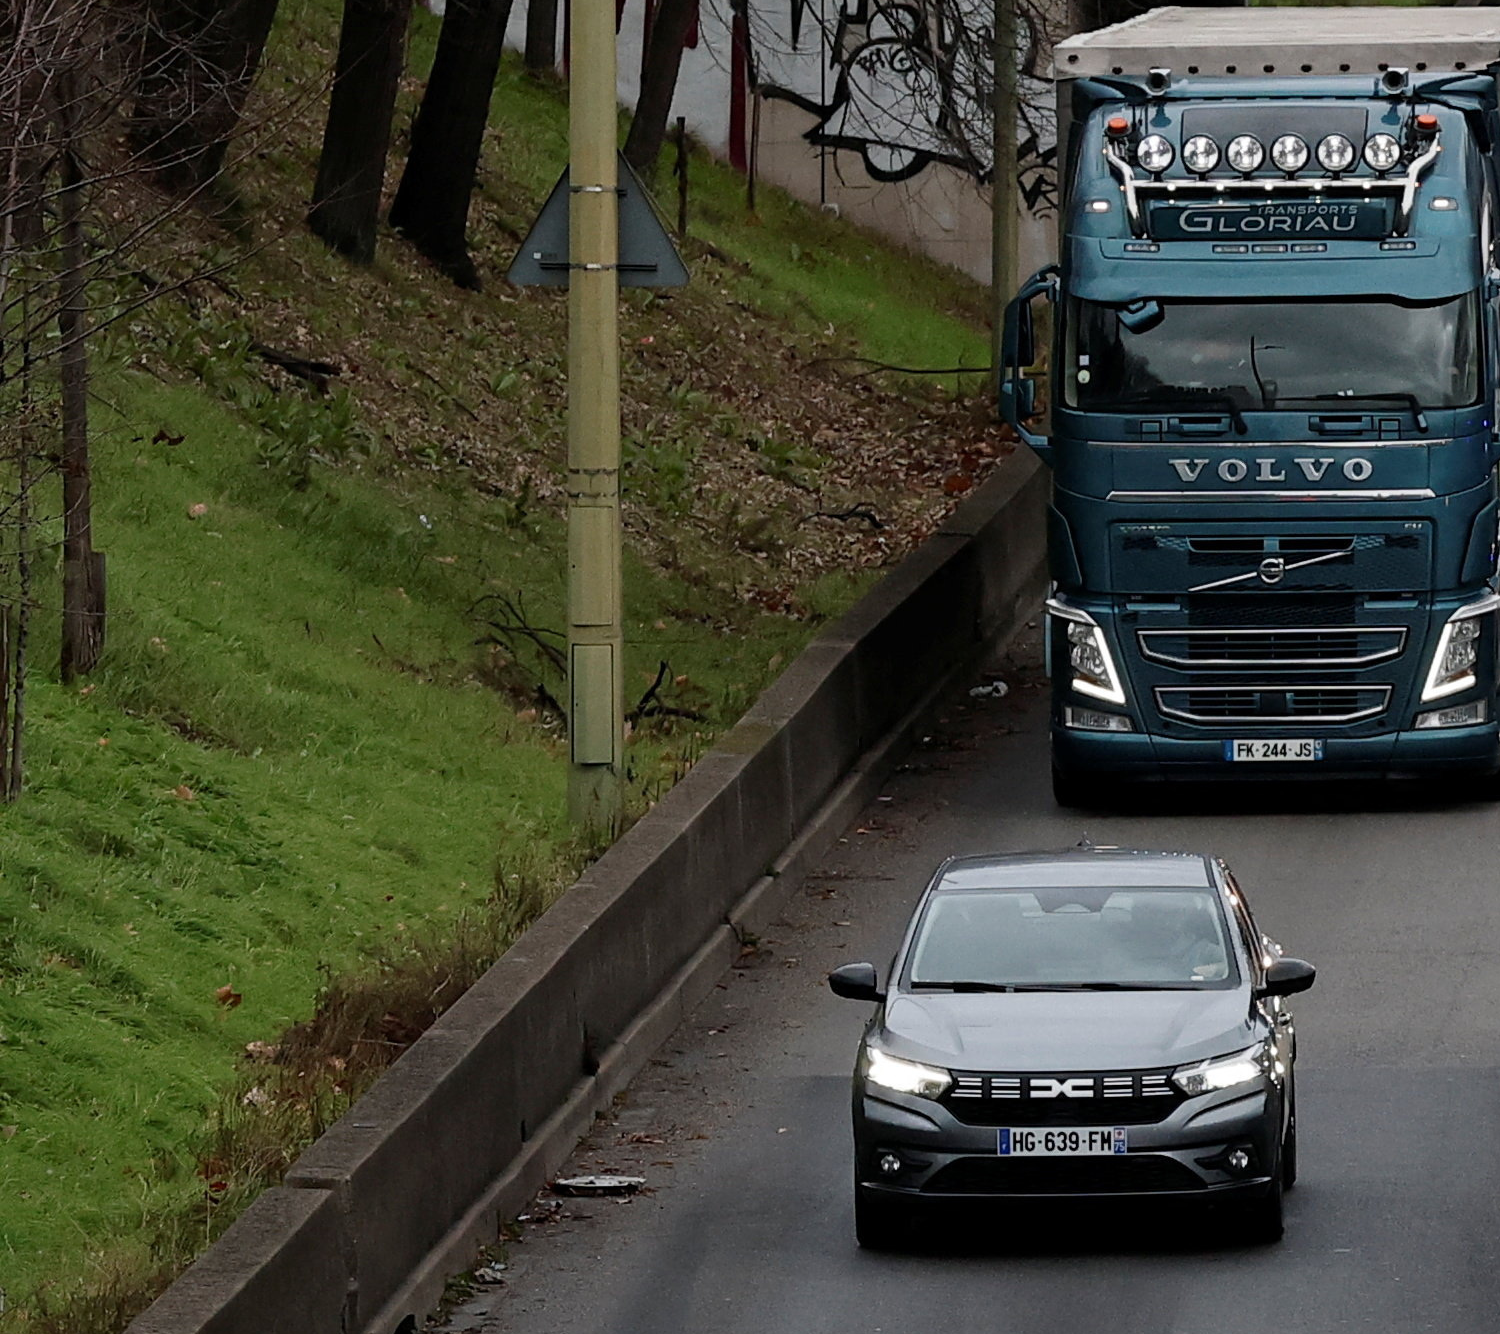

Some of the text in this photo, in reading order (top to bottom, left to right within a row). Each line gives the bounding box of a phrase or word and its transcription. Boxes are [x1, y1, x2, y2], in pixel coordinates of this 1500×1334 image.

[1179, 207, 1357, 232] GLORIAU
[1258, 205, 1358, 215] TRANSPORTS
[1168, 457, 1374, 482] VOLVO
[1238, 742, 1312, 758] FK-244-JS
[1012, 1131, 1113, 1152] HG-639-FM
